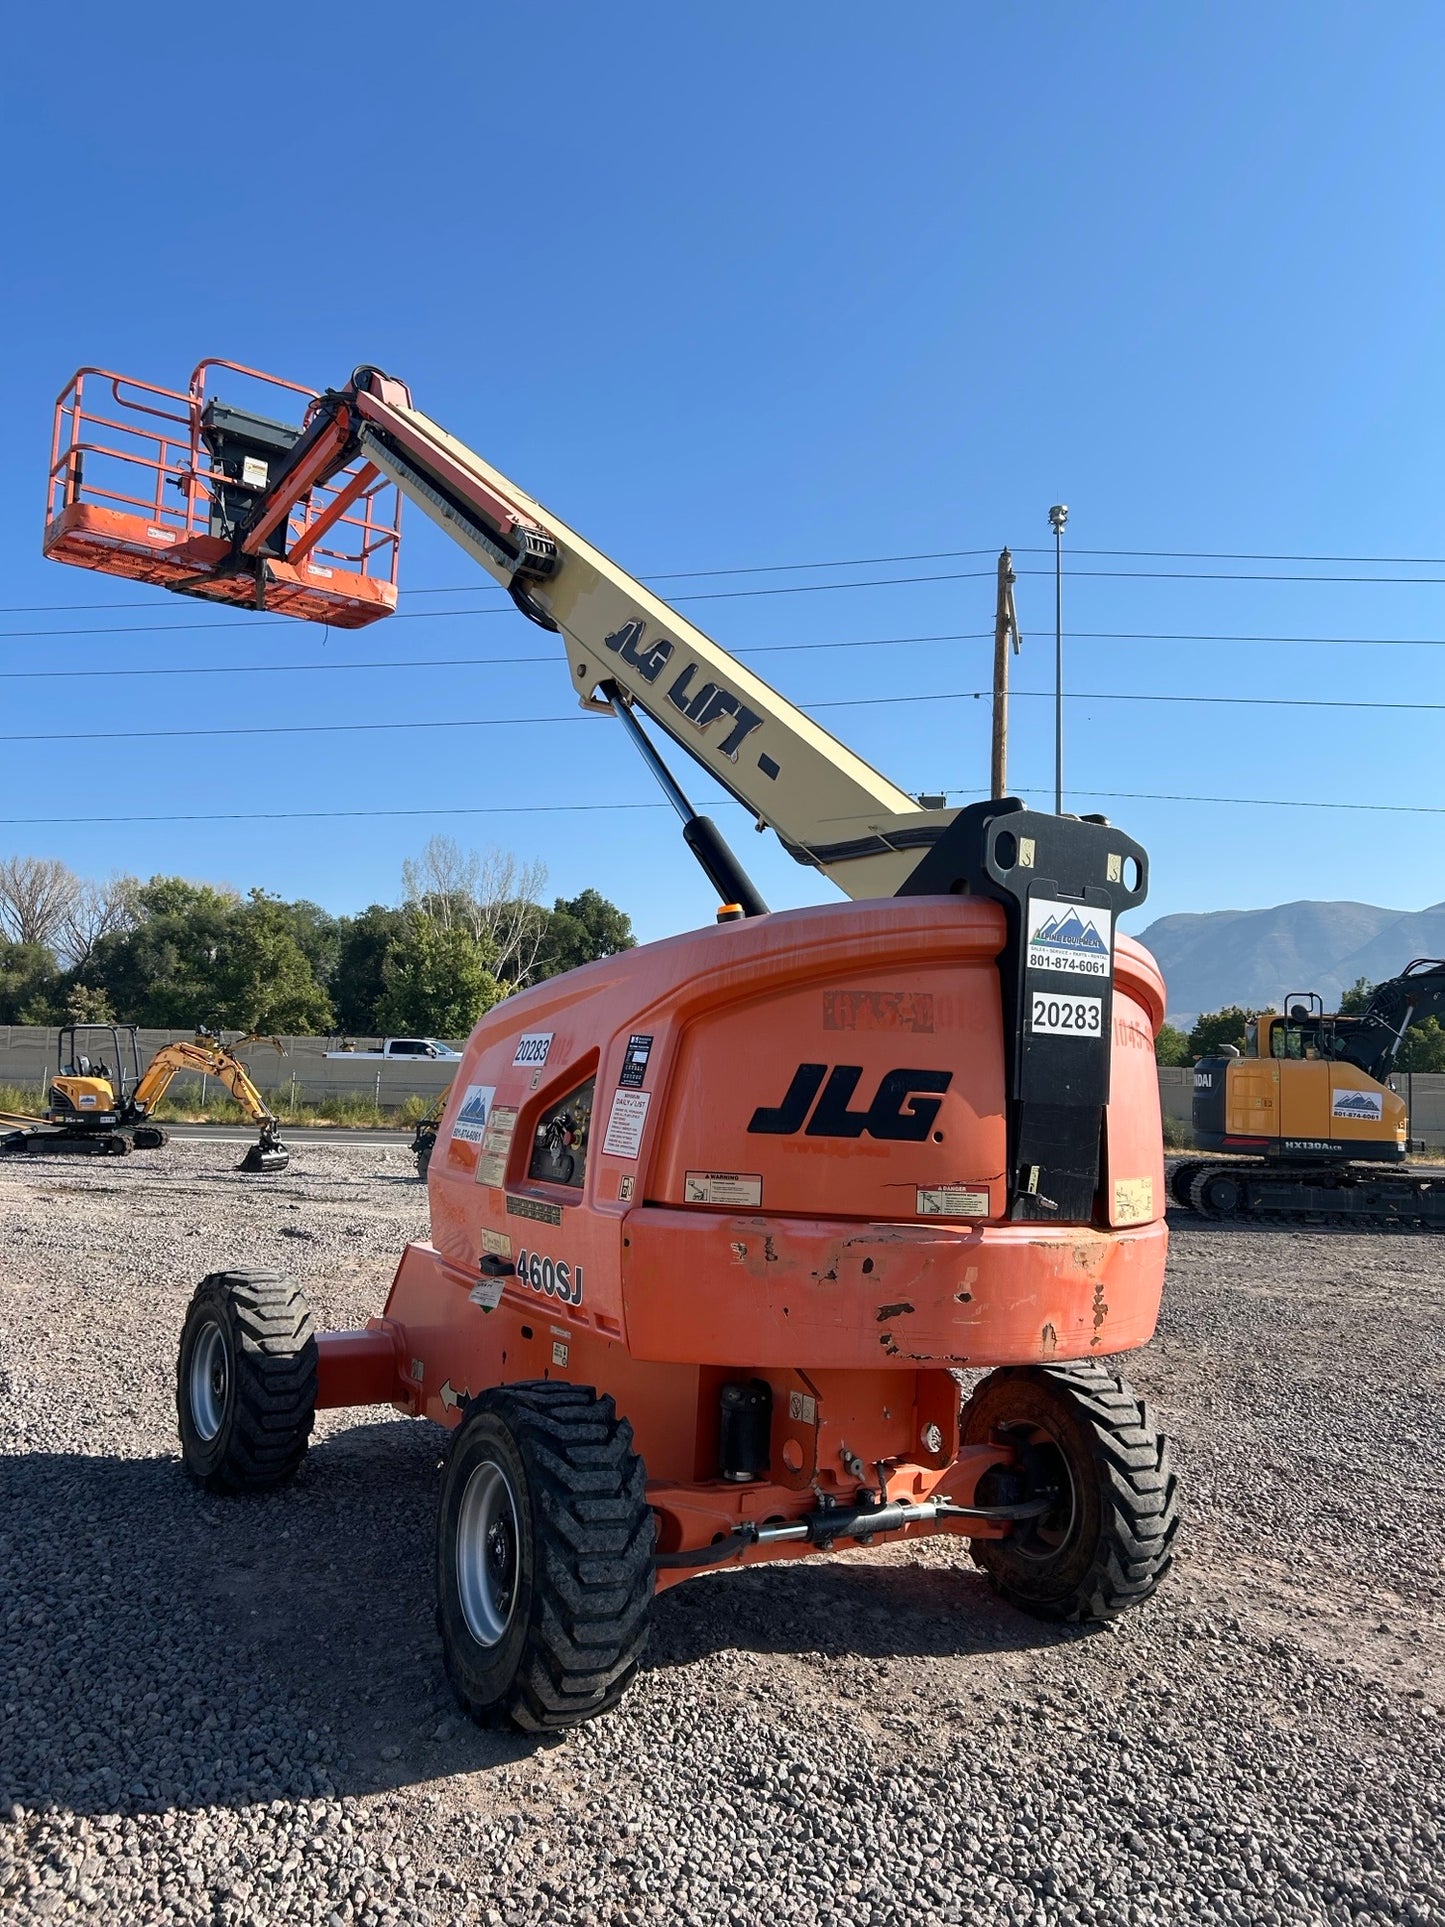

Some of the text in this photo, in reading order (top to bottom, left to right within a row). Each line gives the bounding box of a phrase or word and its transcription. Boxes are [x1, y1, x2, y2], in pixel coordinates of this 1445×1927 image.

[666, 662, 765, 763] LIFT
[1062, 935, 1101, 948] EQUIPMENT
[1049, 948, 1069, 956] SERVICE
[1030, 954, 1105, 974] 801-874-6061
[1033, 1000, 1100, 1030] 20283
[514, 1039, 550, 1061] 20283
[616, 1098, 646, 1108] DAILY LIST
[746, 1063, 954, 1142] JLG
[1333, 1111, 1379, 1120] 801-874-6061
[710, 1173, 739, 1181] WARNING
[516, 1248, 584, 1307] 460SJ
